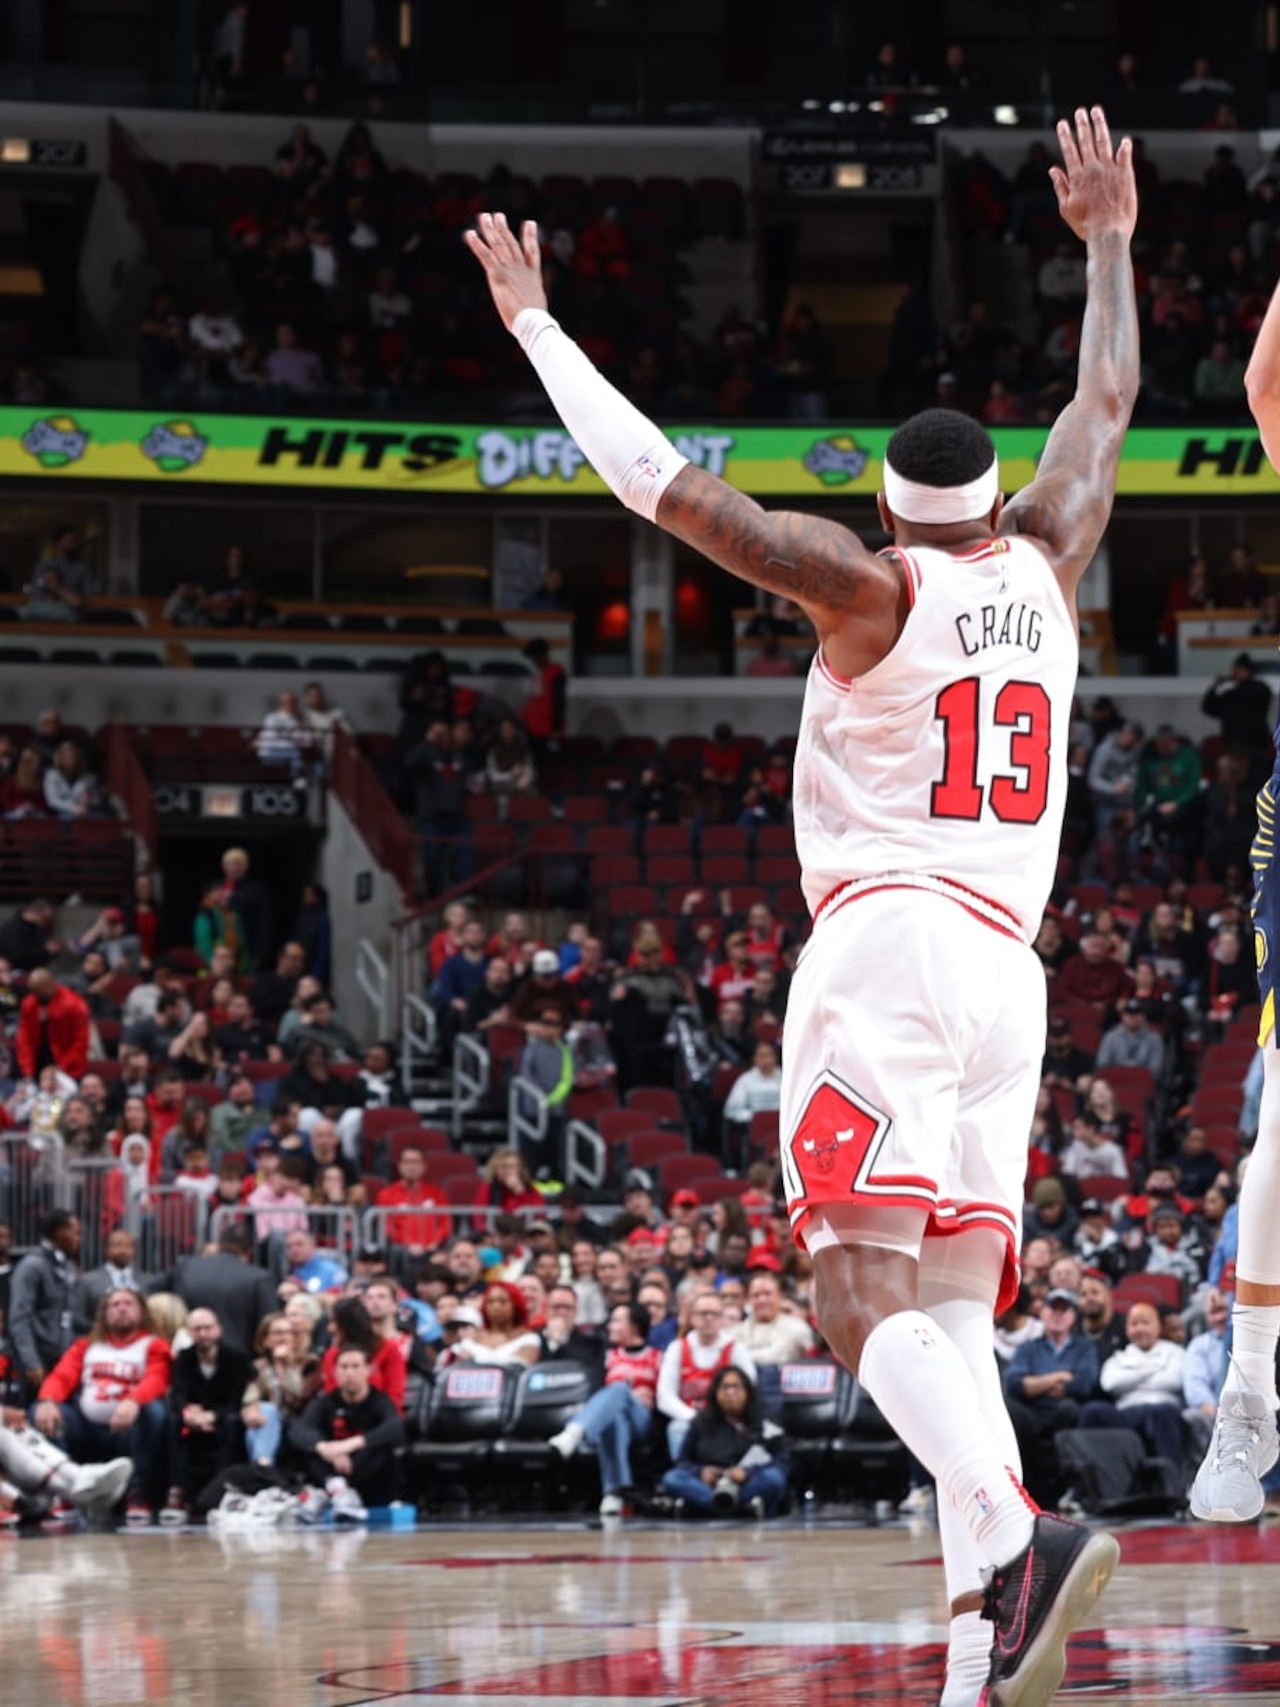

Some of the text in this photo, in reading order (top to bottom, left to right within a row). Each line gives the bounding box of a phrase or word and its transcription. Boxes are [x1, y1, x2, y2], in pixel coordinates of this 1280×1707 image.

[257, 427, 463, 471] HITS
[955, 602, 1043, 657] CRAIG
[930, 676, 1052, 826] 13
